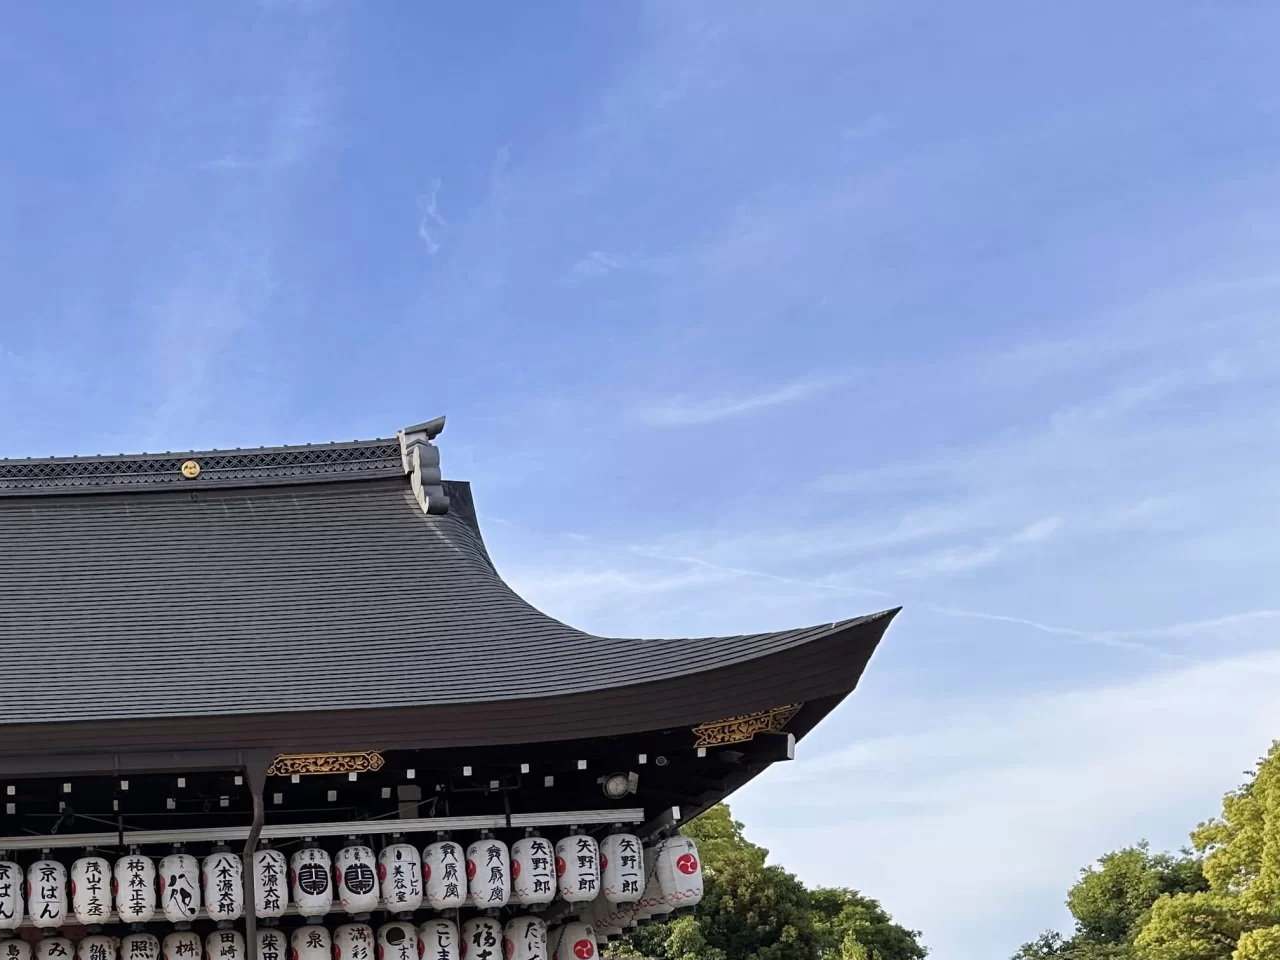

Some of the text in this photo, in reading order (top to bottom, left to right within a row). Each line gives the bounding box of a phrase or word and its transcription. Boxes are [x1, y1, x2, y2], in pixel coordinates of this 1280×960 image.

[39, 864, 60, 919] 京ばん
[85, 861, 104, 916] 茂山千之丞
[214, 856, 235, 915] 八木源太郎
[259, 853, 280, 911] 八木源太郎
[393, 865, 408, 902] 美容室
[531, 841, 550, 894] 矢野一郎
[577, 838, 595, 892] 矢野一郎
[620, 839, 639, 894] 矢野一郎
